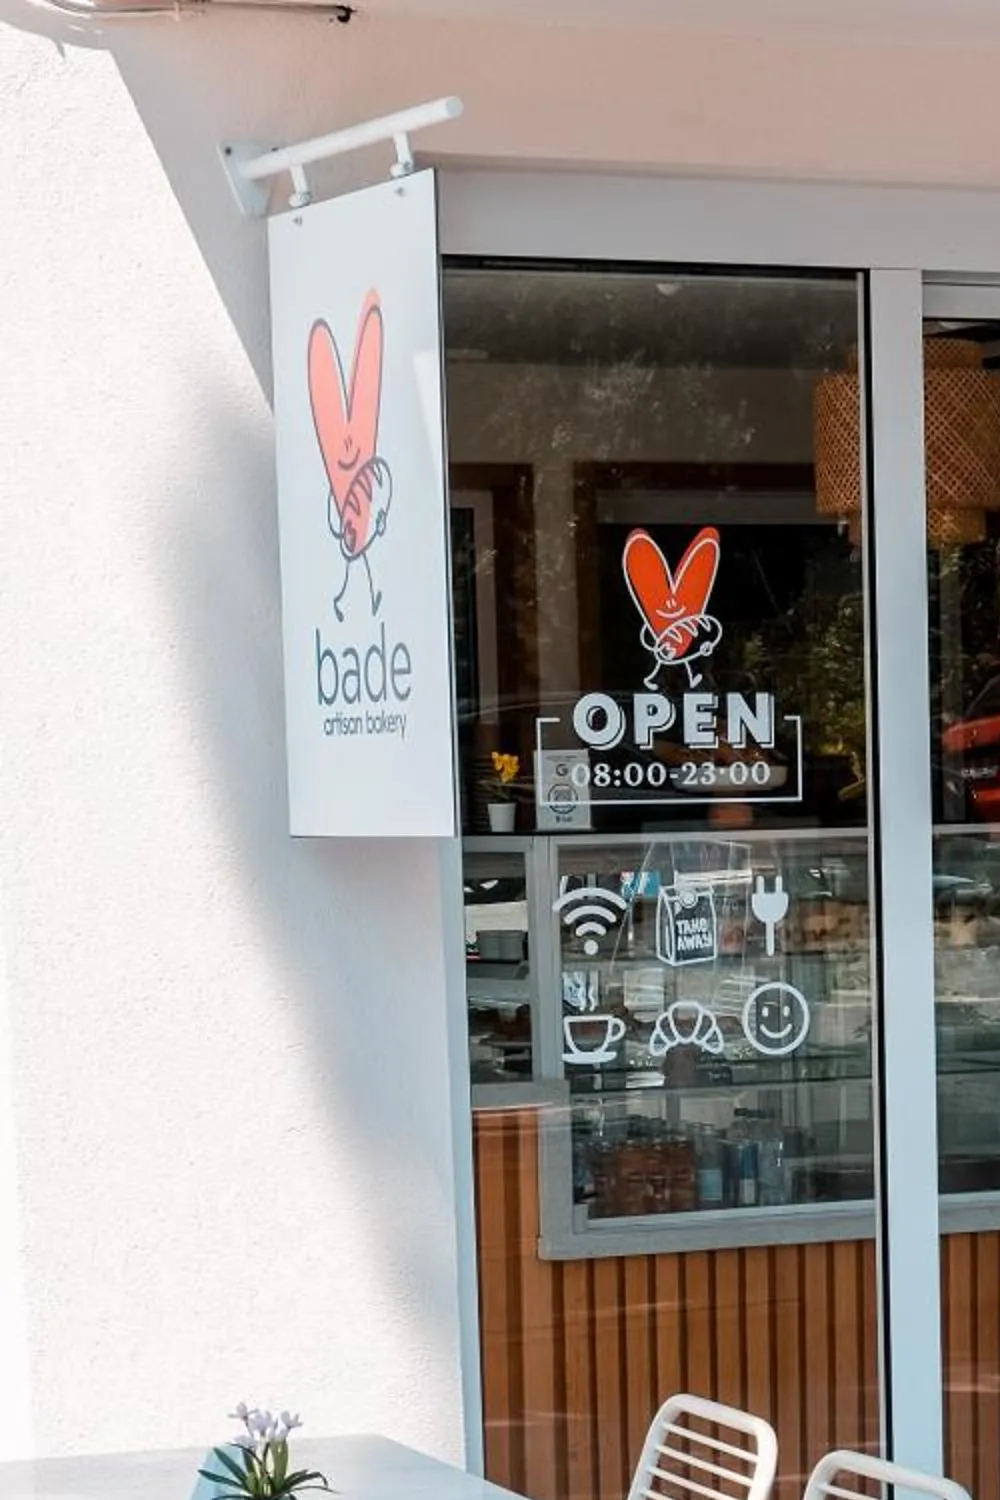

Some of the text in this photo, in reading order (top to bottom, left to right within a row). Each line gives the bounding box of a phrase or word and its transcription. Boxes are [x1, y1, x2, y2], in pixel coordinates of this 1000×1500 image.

[315, 621, 412, 706] bade
[323, 709, 407, 741] artisan bakery
[573, 691, 775, 751] OPEN
[677, 931, 713, 951] AWAY
